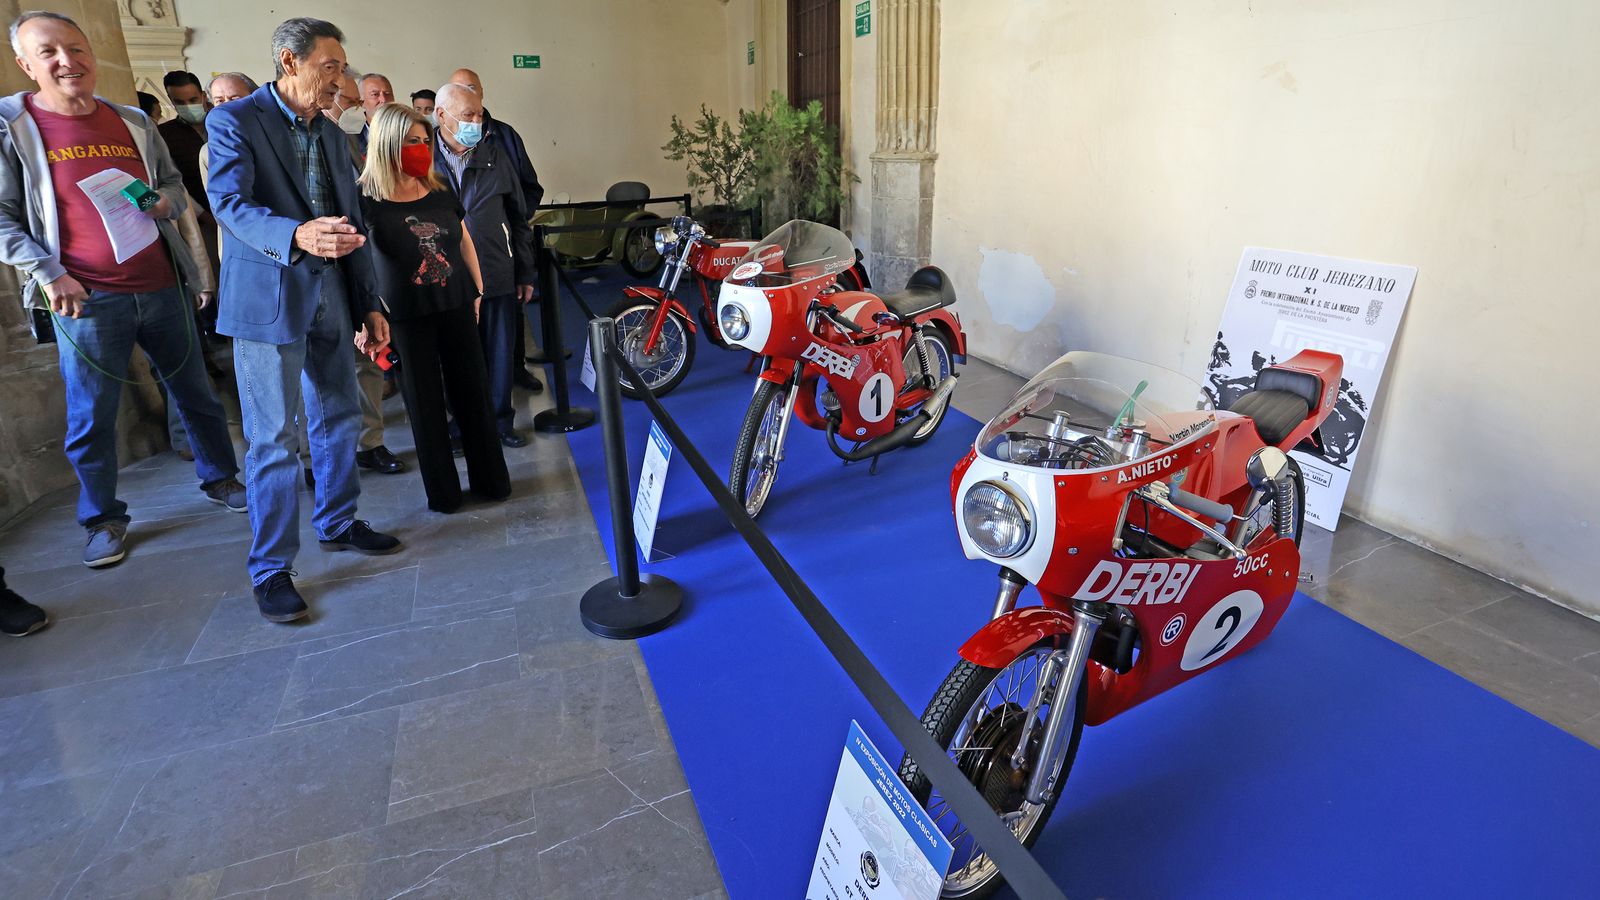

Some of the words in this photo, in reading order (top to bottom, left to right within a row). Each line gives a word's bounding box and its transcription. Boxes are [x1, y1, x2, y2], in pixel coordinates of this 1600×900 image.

[46, 144, 138, 163] ANGAROOS
[713, 256, 742, 267] DUCAT
[1248, 259, 1283, 276] MOTO
[1286, 264, 1319, 281] CLUB
[1322, 269, 1397, 294] JEREZANO
[1303, 286, 1317, 295] XI
[1260, 289, 1276, 299] PREMIO
[1276, 292, 1309, 305] INTERNACIONAL
[1323, 300, 1331, 309] DE
[1331, 302, 1338, 311] LA
[1339, 303, 1360, 315] MERCED
[870, 378, 882, 417] 1
[1117, 455, 1172, 484] A.NIETO
[1304, 510, 1321, 520] CIAL
[1071, 559, 1202, 605] DERBI
[1199, 605, 1242, 662] 2
[860, 743, 887, 780] EXPOSICIÓN
[886, 778, 894, 791] DE
[893, 787, 911, 813] MOTOS
[910, 811, 938, 849] CLASICAS
[876, 778, 893, 801] JEREZ
[892, 799, 906, 820] 2022
[844, 885, 854, 899] GT
